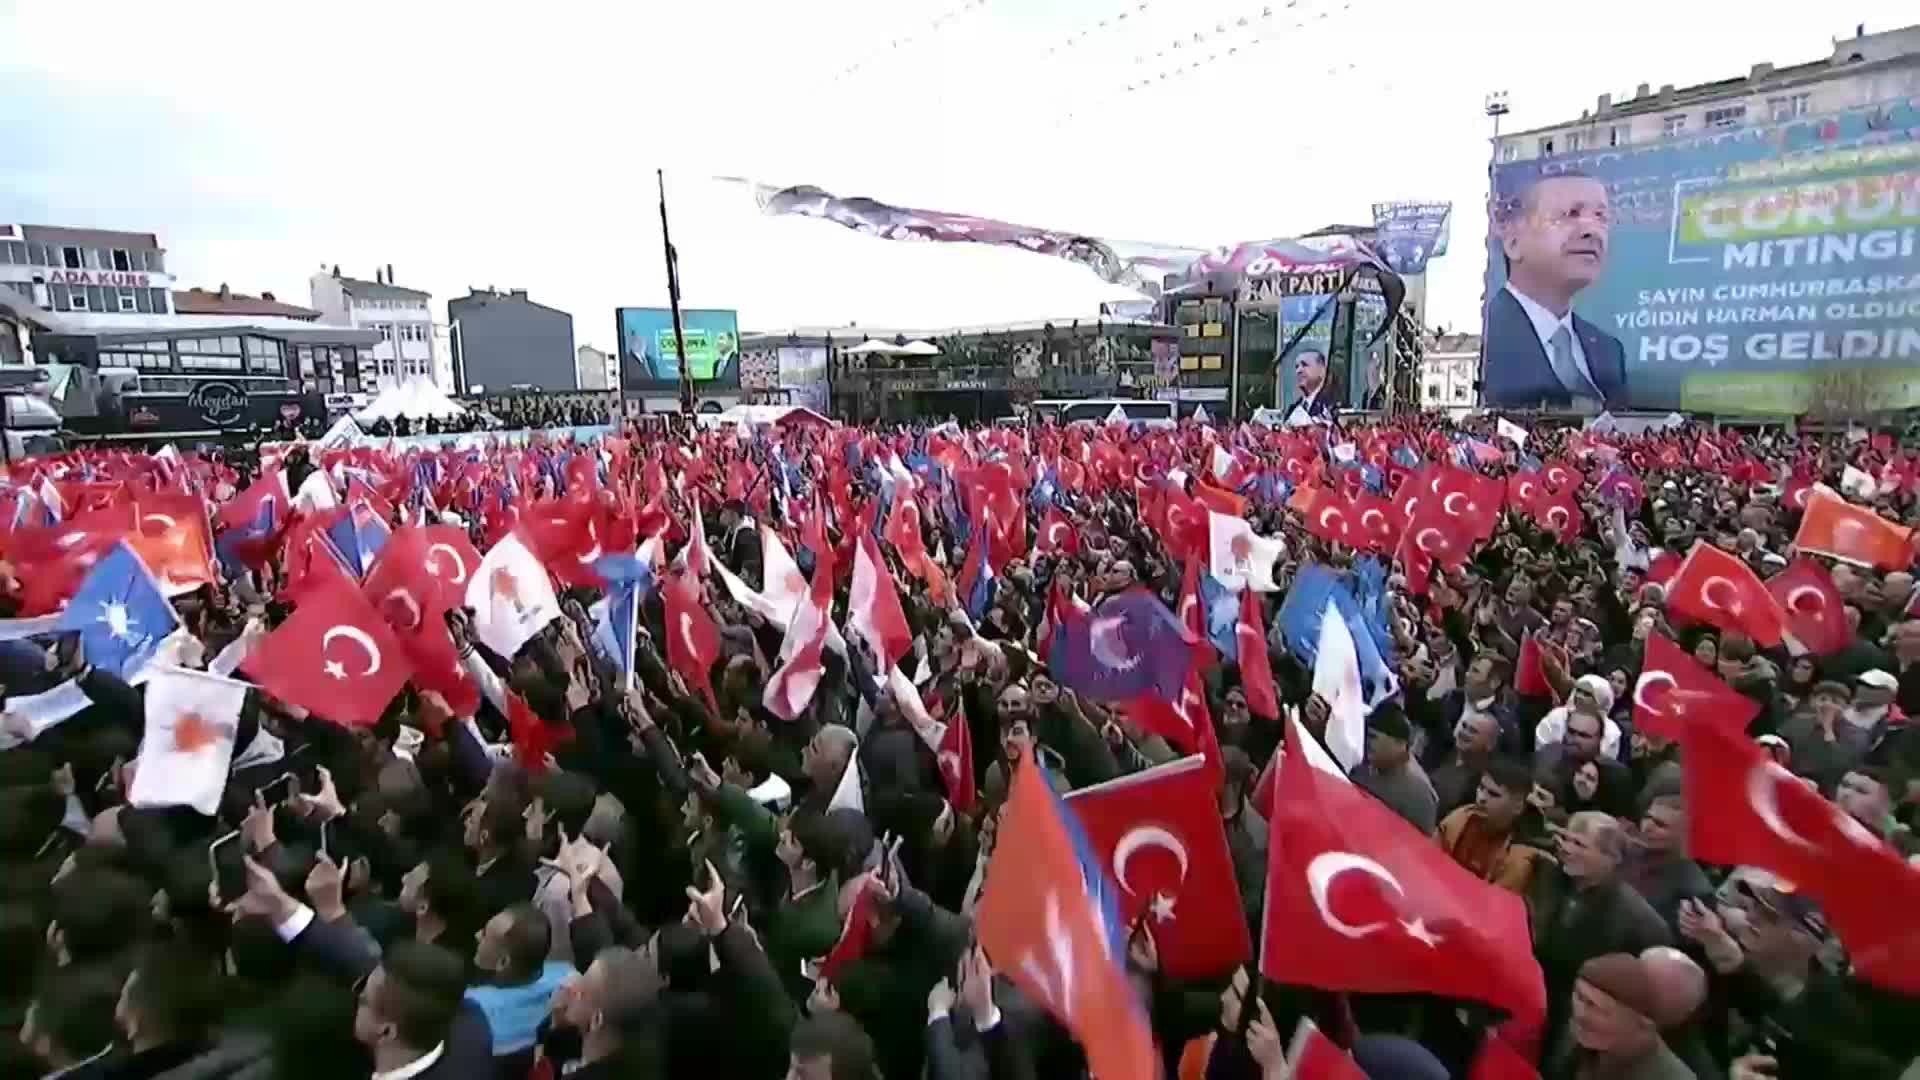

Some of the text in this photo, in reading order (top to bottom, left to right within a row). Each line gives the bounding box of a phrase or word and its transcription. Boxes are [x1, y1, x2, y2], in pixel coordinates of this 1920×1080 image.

[50, 270, 92, 284] ADA
[1638, 287, 1705, 305] SAYIN
[1706, 303, 1817, 324] HARMAN
[1639, 333, 1729, 368] HOŞ
